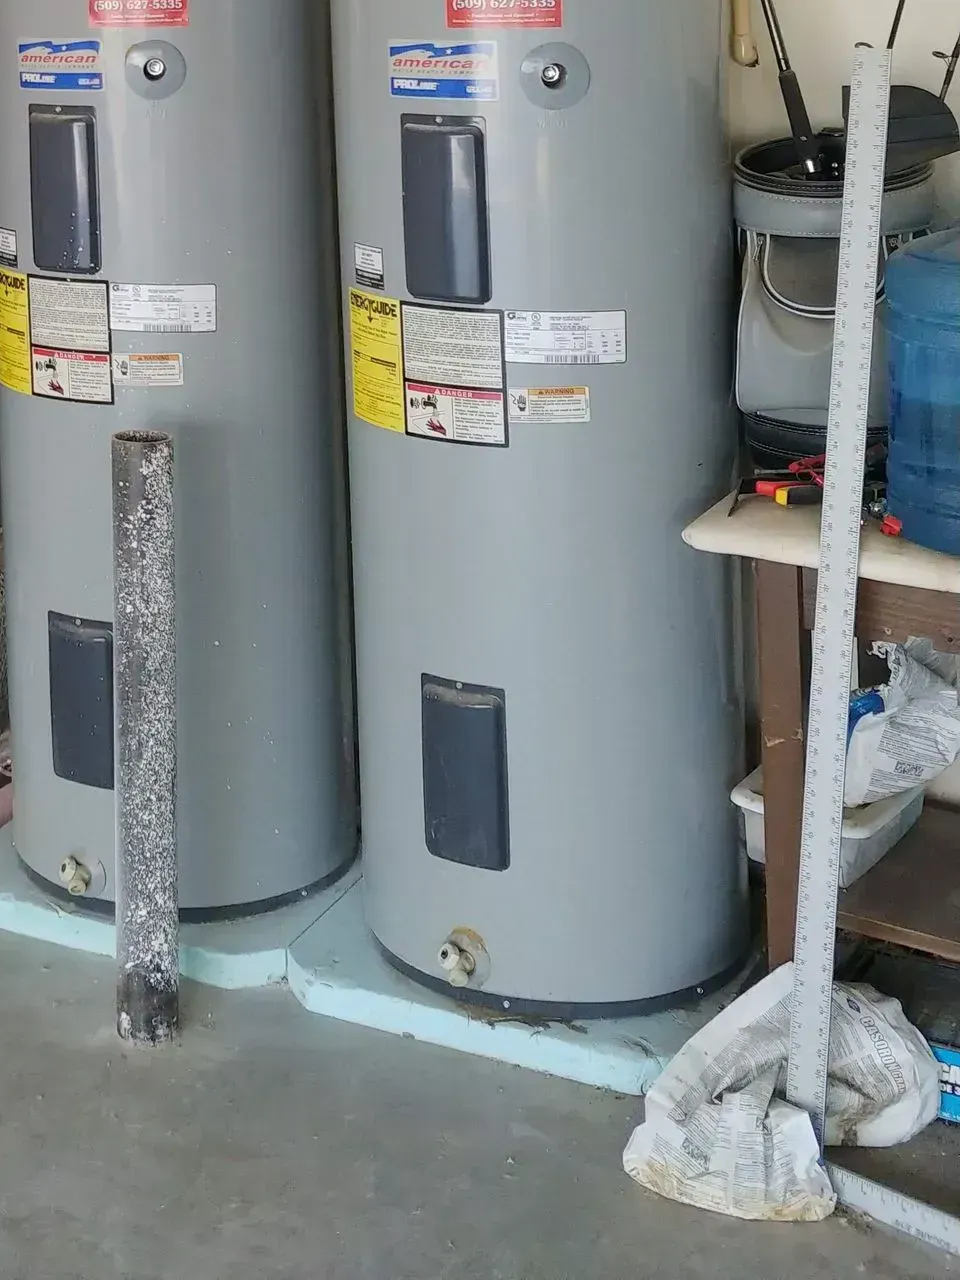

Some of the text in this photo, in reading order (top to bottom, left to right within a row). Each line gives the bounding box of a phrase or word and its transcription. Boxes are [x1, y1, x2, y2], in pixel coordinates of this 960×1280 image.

[94, 0, 183, 12] (509) 627-5335
[21, 54, 97, 63] american
[441, 390, 474, 399] DANGER
